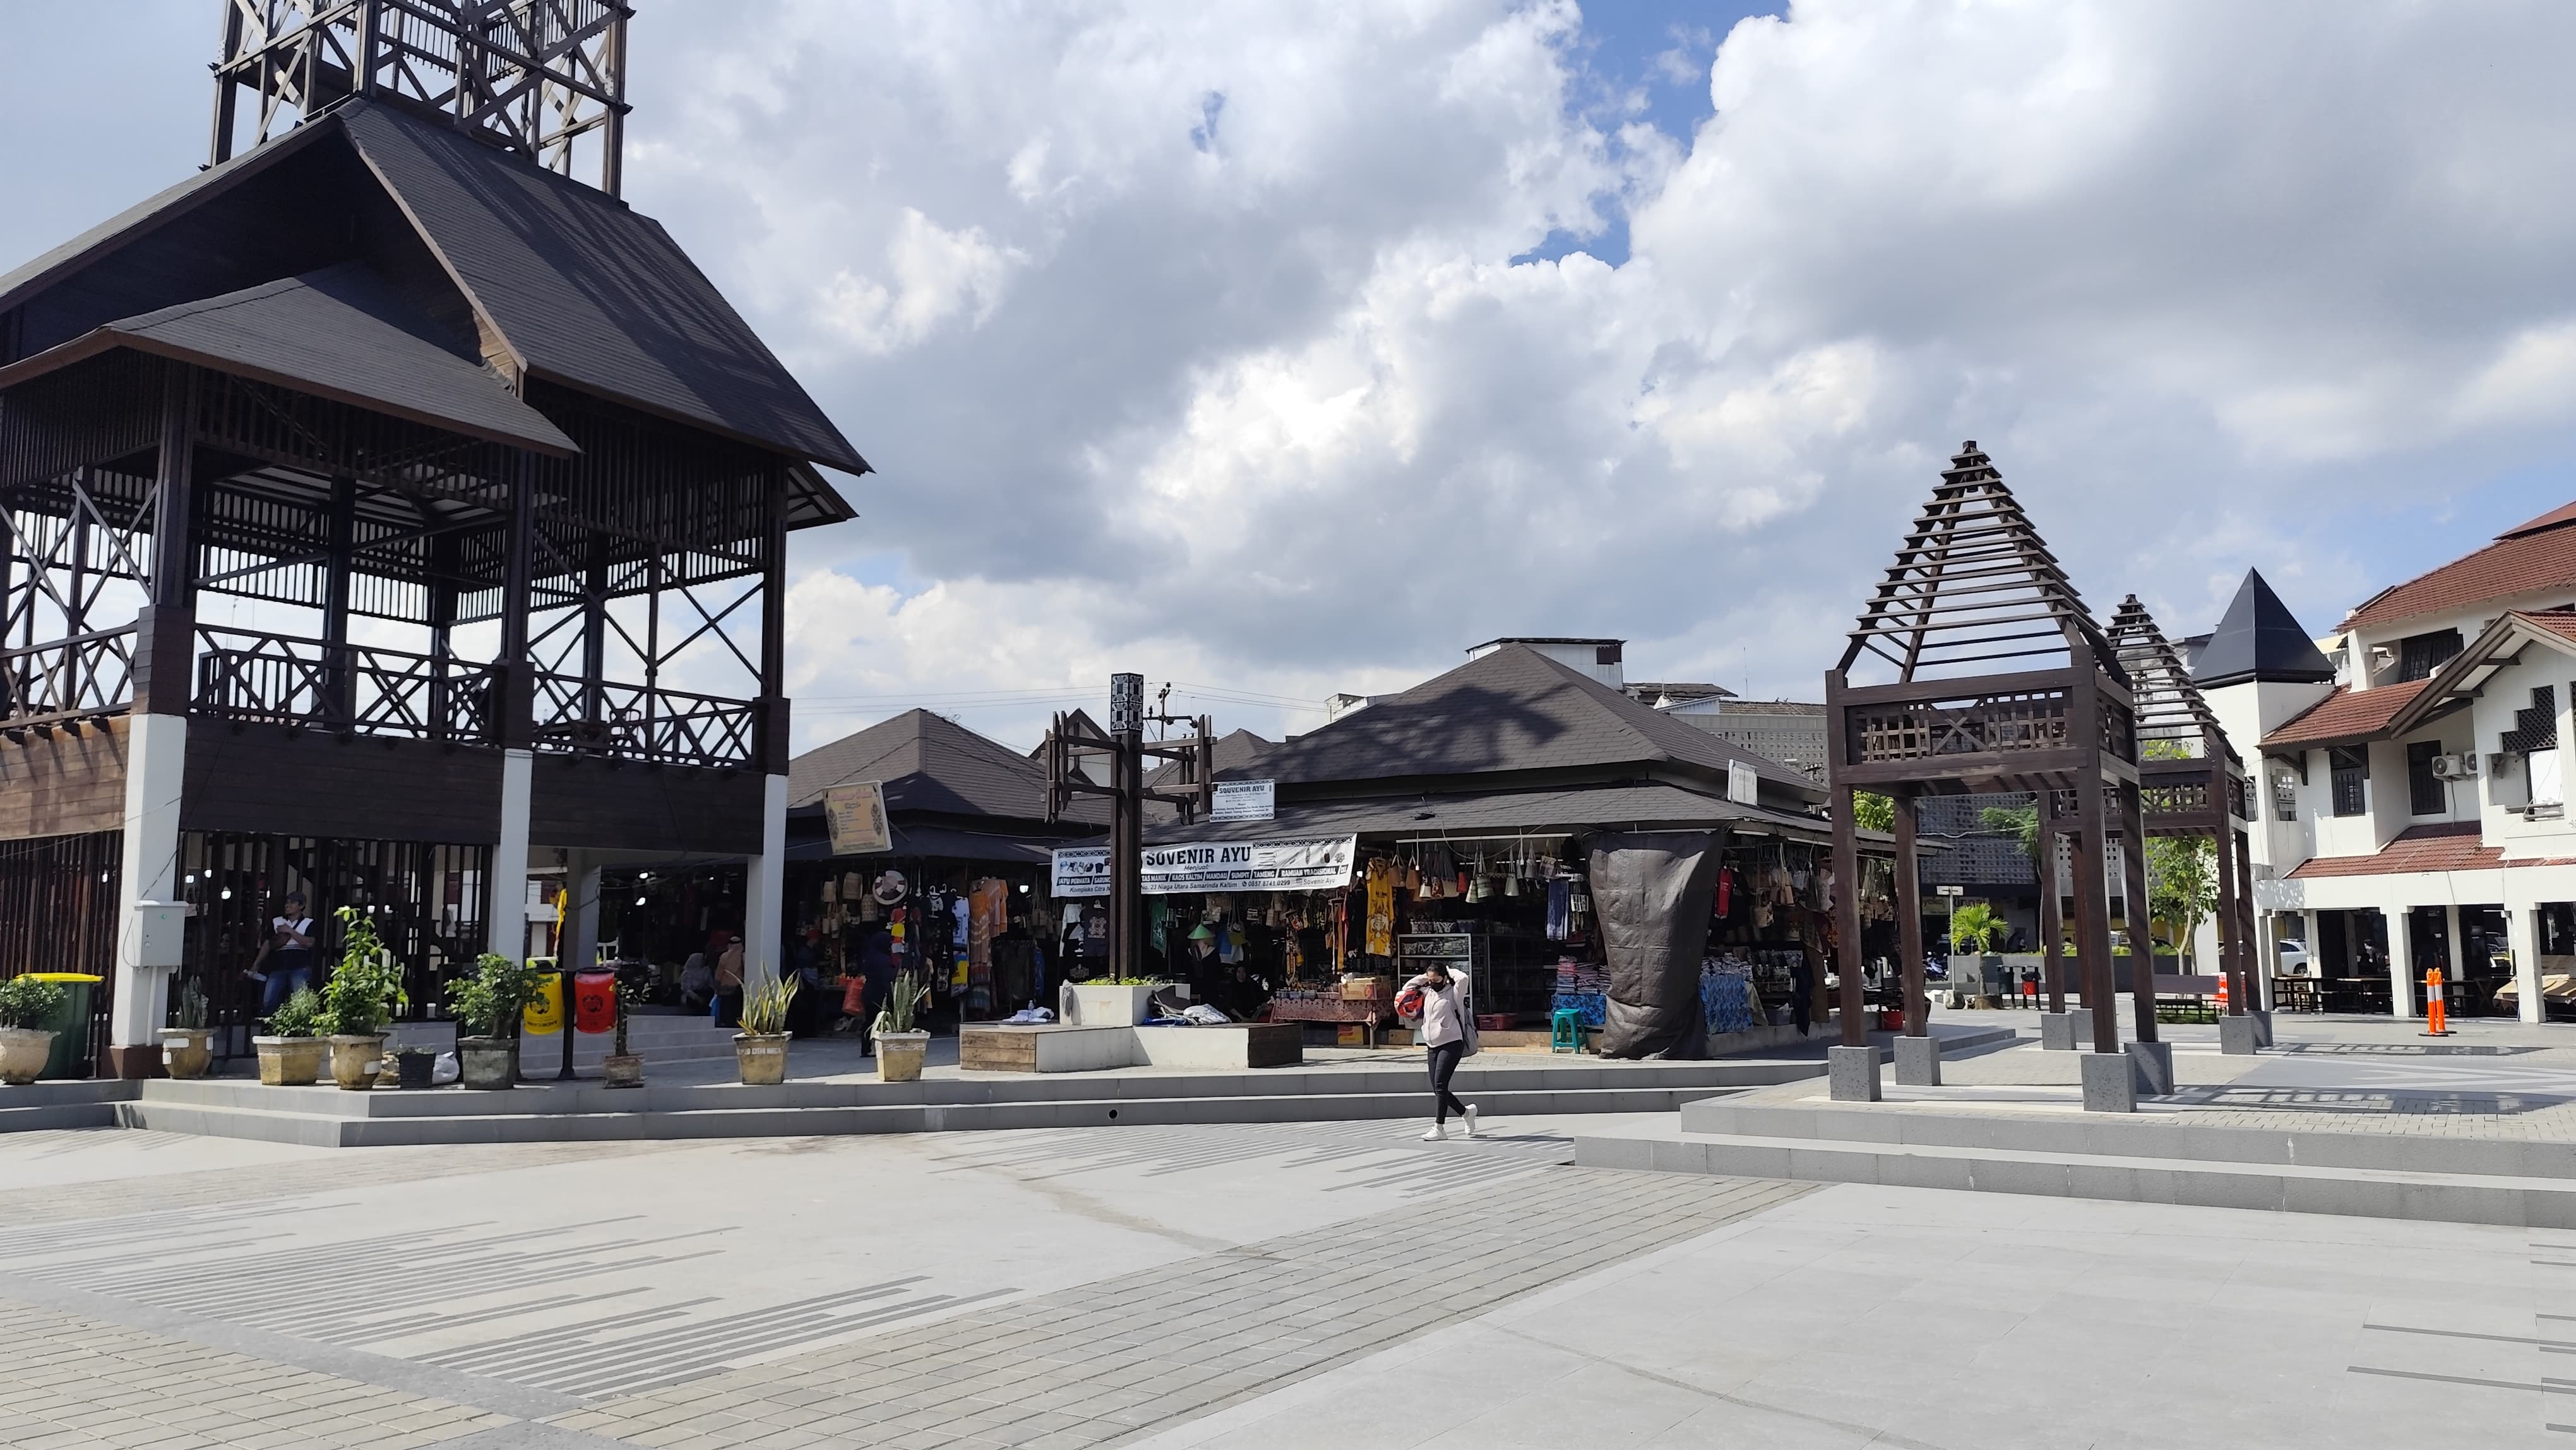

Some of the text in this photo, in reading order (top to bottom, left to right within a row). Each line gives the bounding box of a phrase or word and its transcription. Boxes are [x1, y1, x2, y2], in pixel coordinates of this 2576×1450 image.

[1219, 786, 1251, 794] SOUVENIR
[1146, 846, 1251, 866] SOVENIR AYU
[1281, 867, 1336, 877] RAMUAN TRADISIONAL
